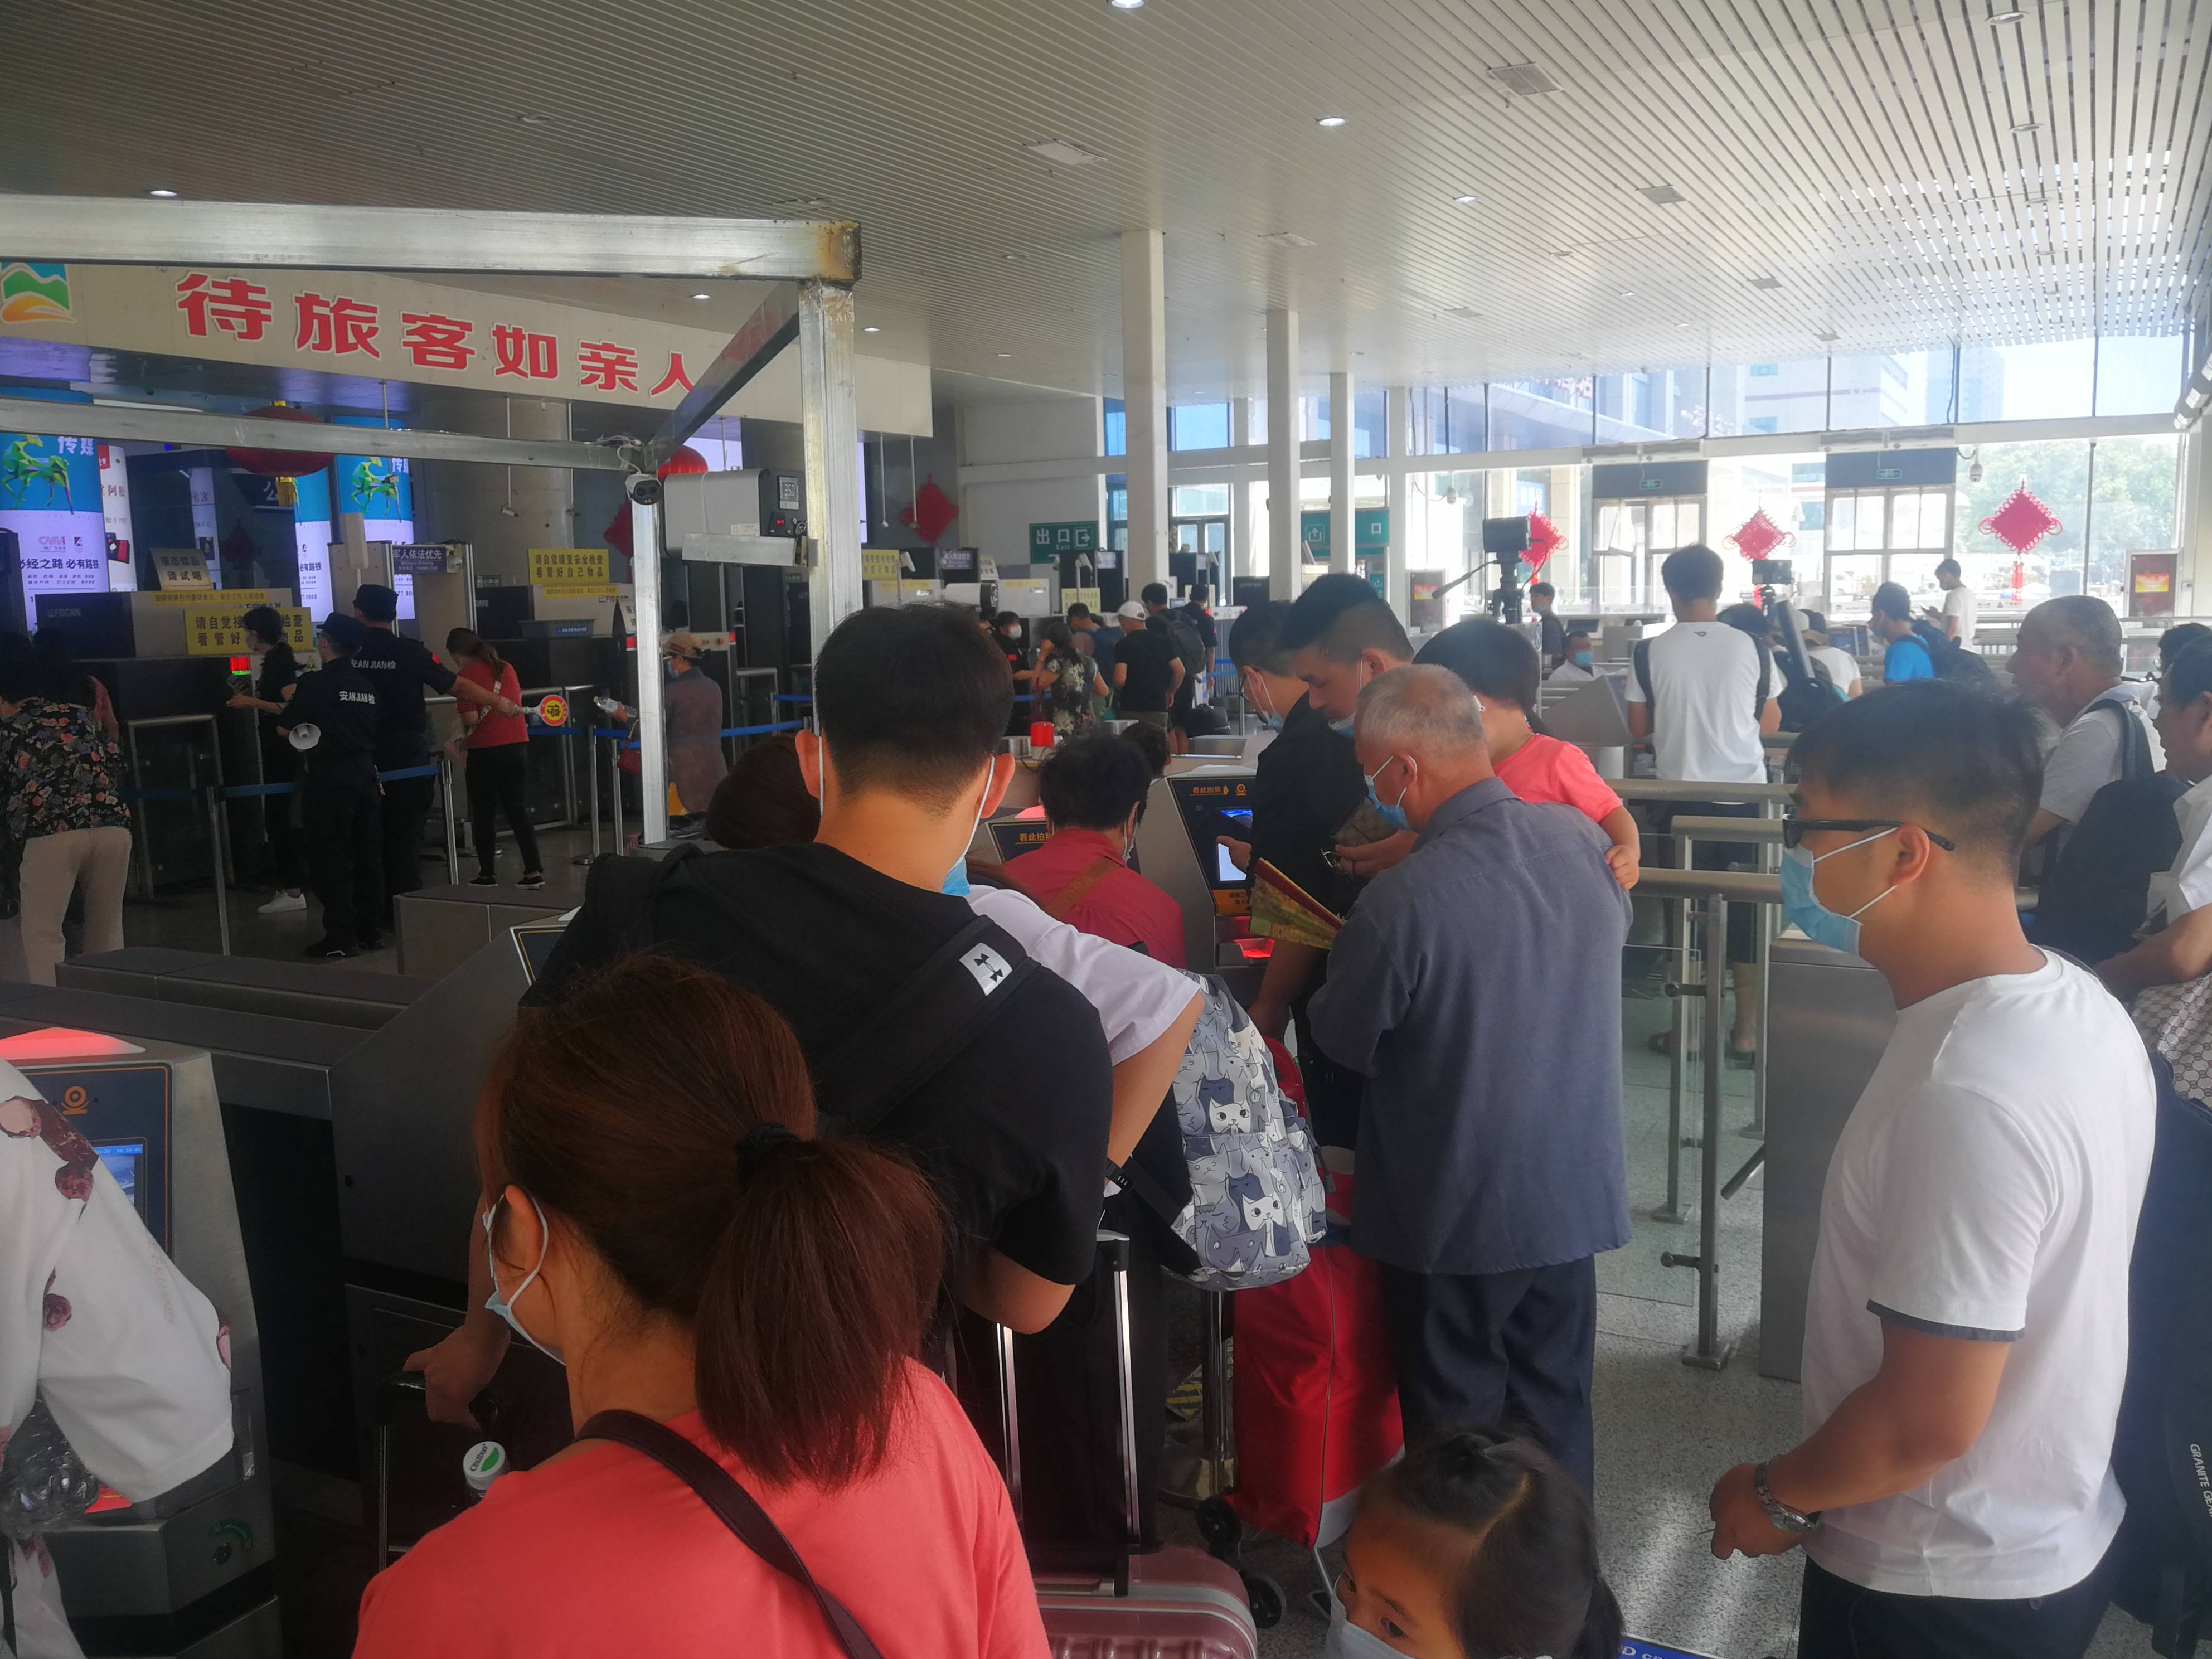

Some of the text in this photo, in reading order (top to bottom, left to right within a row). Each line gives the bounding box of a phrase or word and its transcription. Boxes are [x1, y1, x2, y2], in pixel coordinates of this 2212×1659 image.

[177, 273, 694, 397] 待旅客如亲人
[1036, 528, 1070, 544] 出口
[393, 548, 442, 559] 军人依法优先
[196, 614, 303, 630] 请自觉接检查
[198, 630, 304, 647] 看管好物品
[546, 704, 562, 718] 停
[1192, 785, 1221, 794] 看此拍照
[2190, 1443, 2212, 1518] GRANITE GEA
